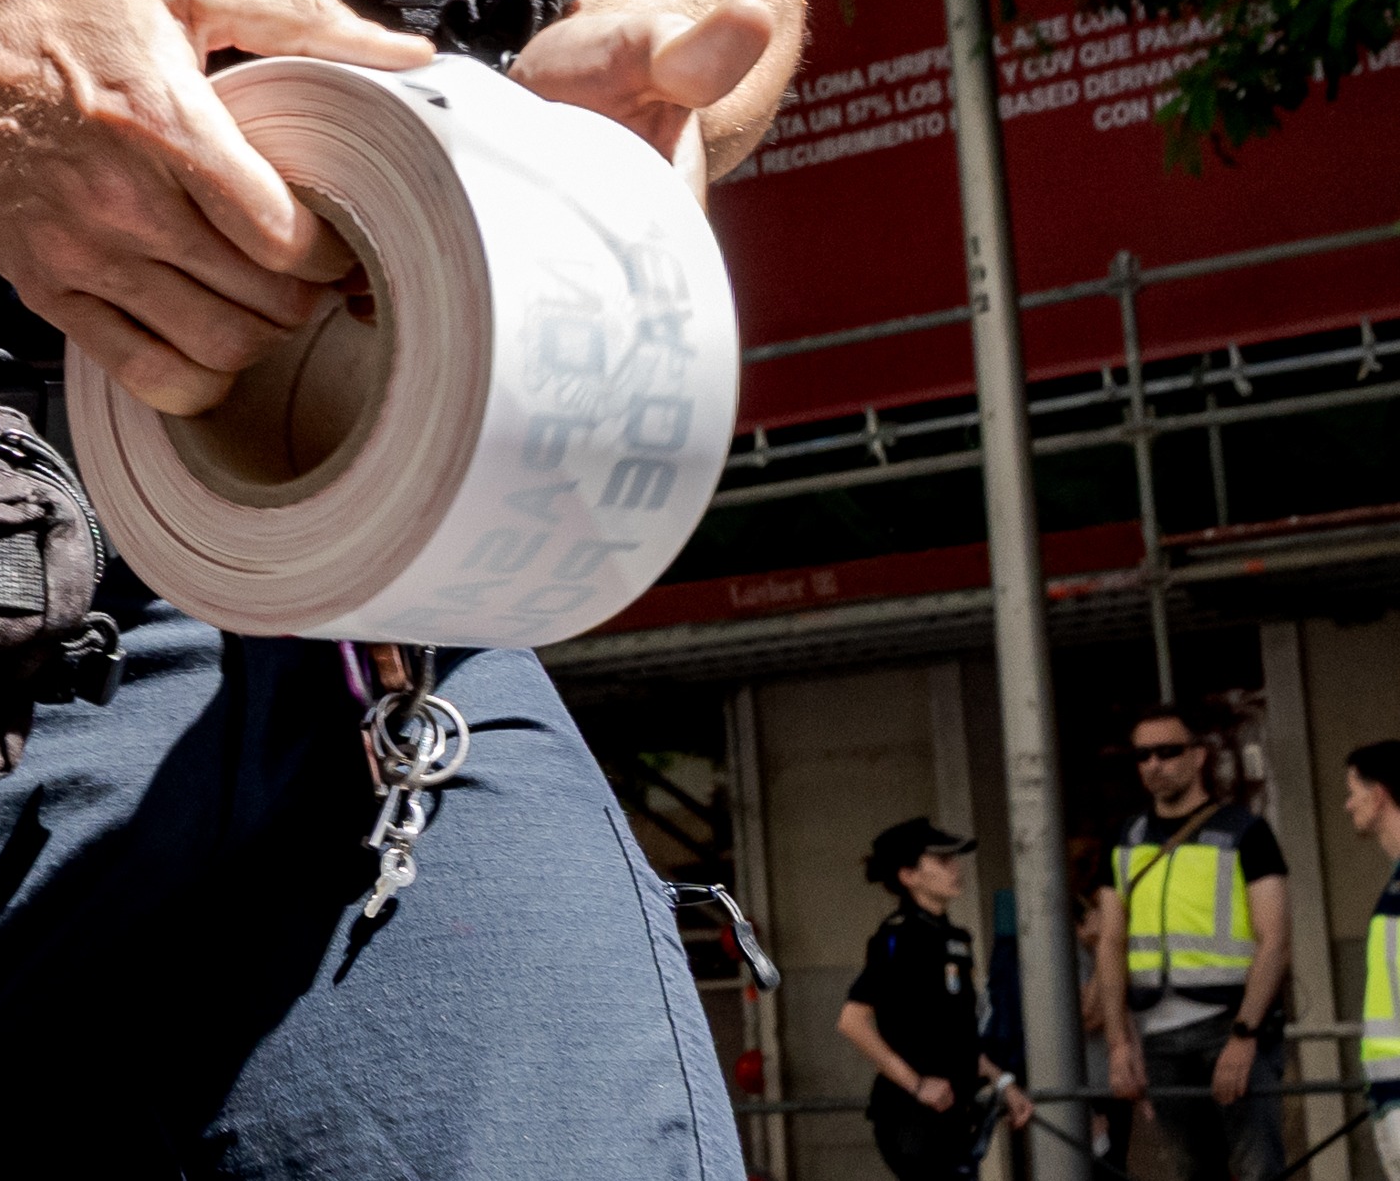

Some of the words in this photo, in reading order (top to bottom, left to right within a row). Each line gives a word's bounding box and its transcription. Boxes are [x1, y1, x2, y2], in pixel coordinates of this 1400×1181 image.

[894, 79, 944, 113] LOS
[1078, 32, 1134, 68] QUE
[1092, 95, 1151, 132] CON
